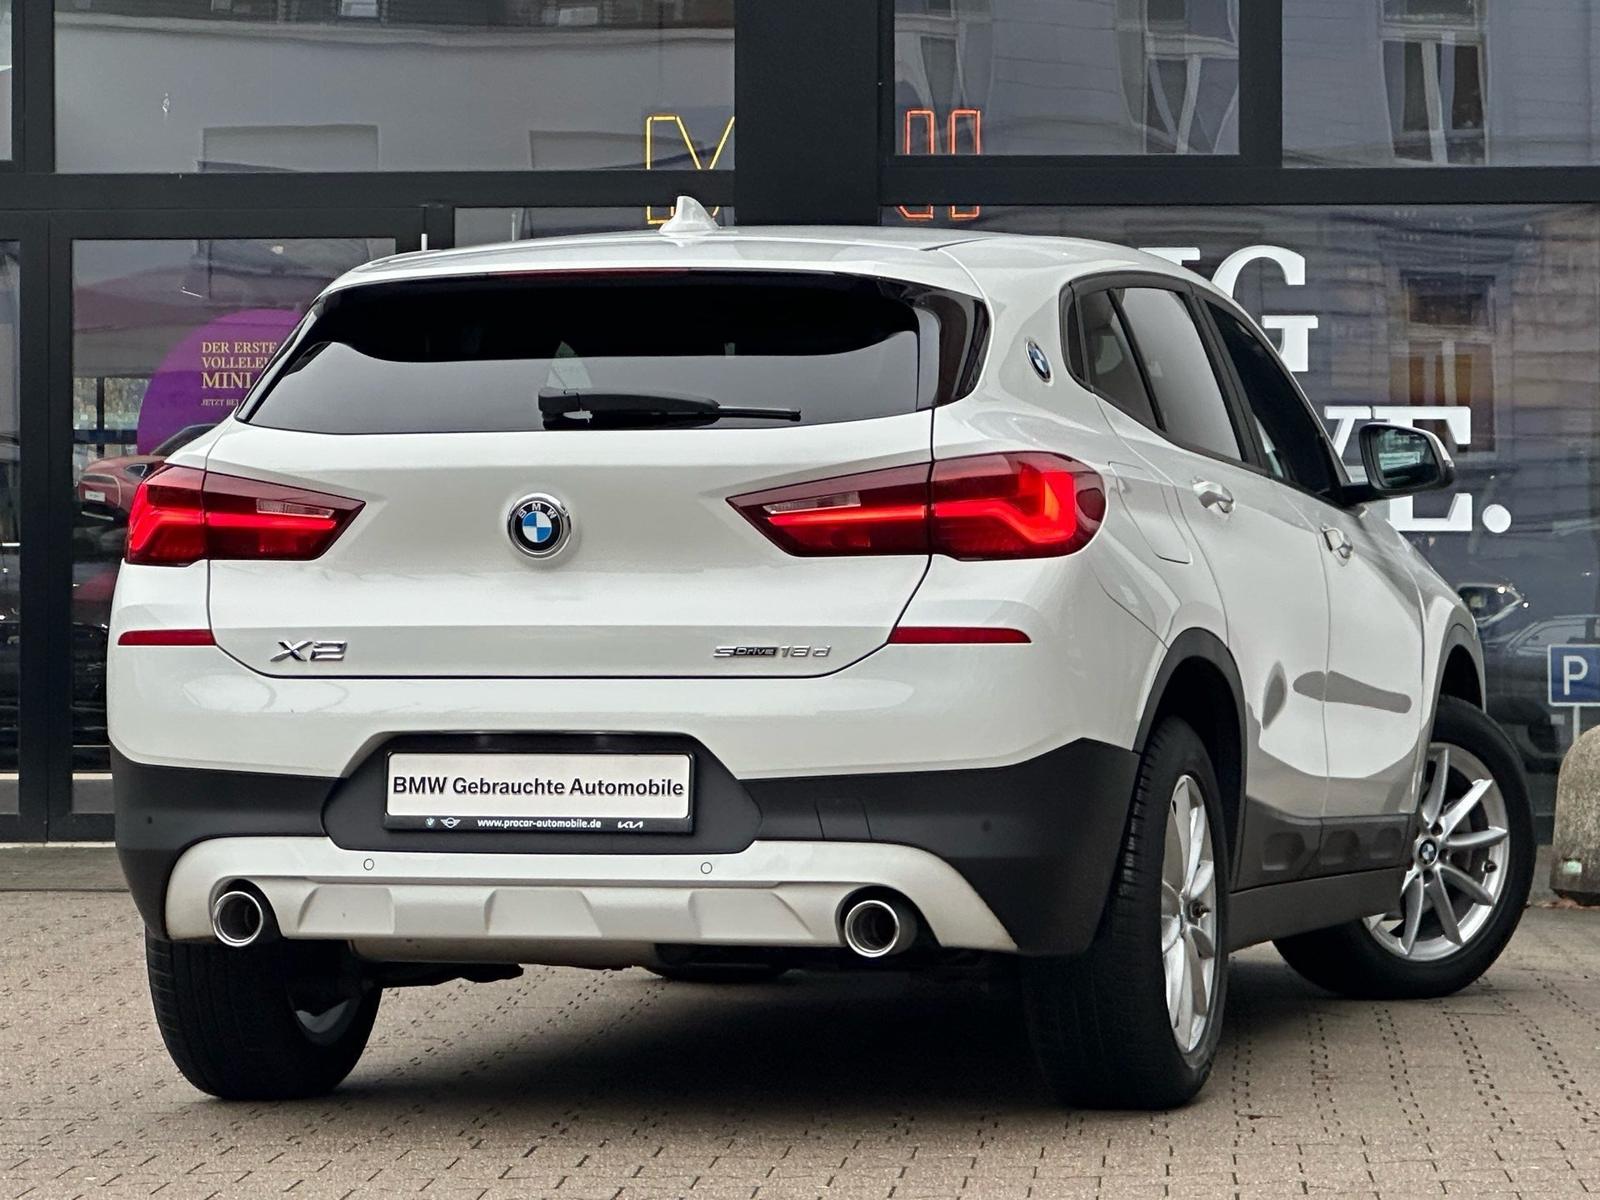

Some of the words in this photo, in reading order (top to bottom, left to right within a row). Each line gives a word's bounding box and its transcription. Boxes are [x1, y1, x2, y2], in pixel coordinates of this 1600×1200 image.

[202, 341, 230, 353] DER
[234, 341, 277, 353] ERSTE
[201, 372, 252, 388] MINI
[270, 640, 347, 661] X2
[1563, 655, 1588, 696] P
[393, 776, 447, 794] BMW
[452, 777, 565, 795] Gebrauchte
[569, 777, 684, 796] Automobile
[477, 819, 602, 829] www.procar-automobile.de
